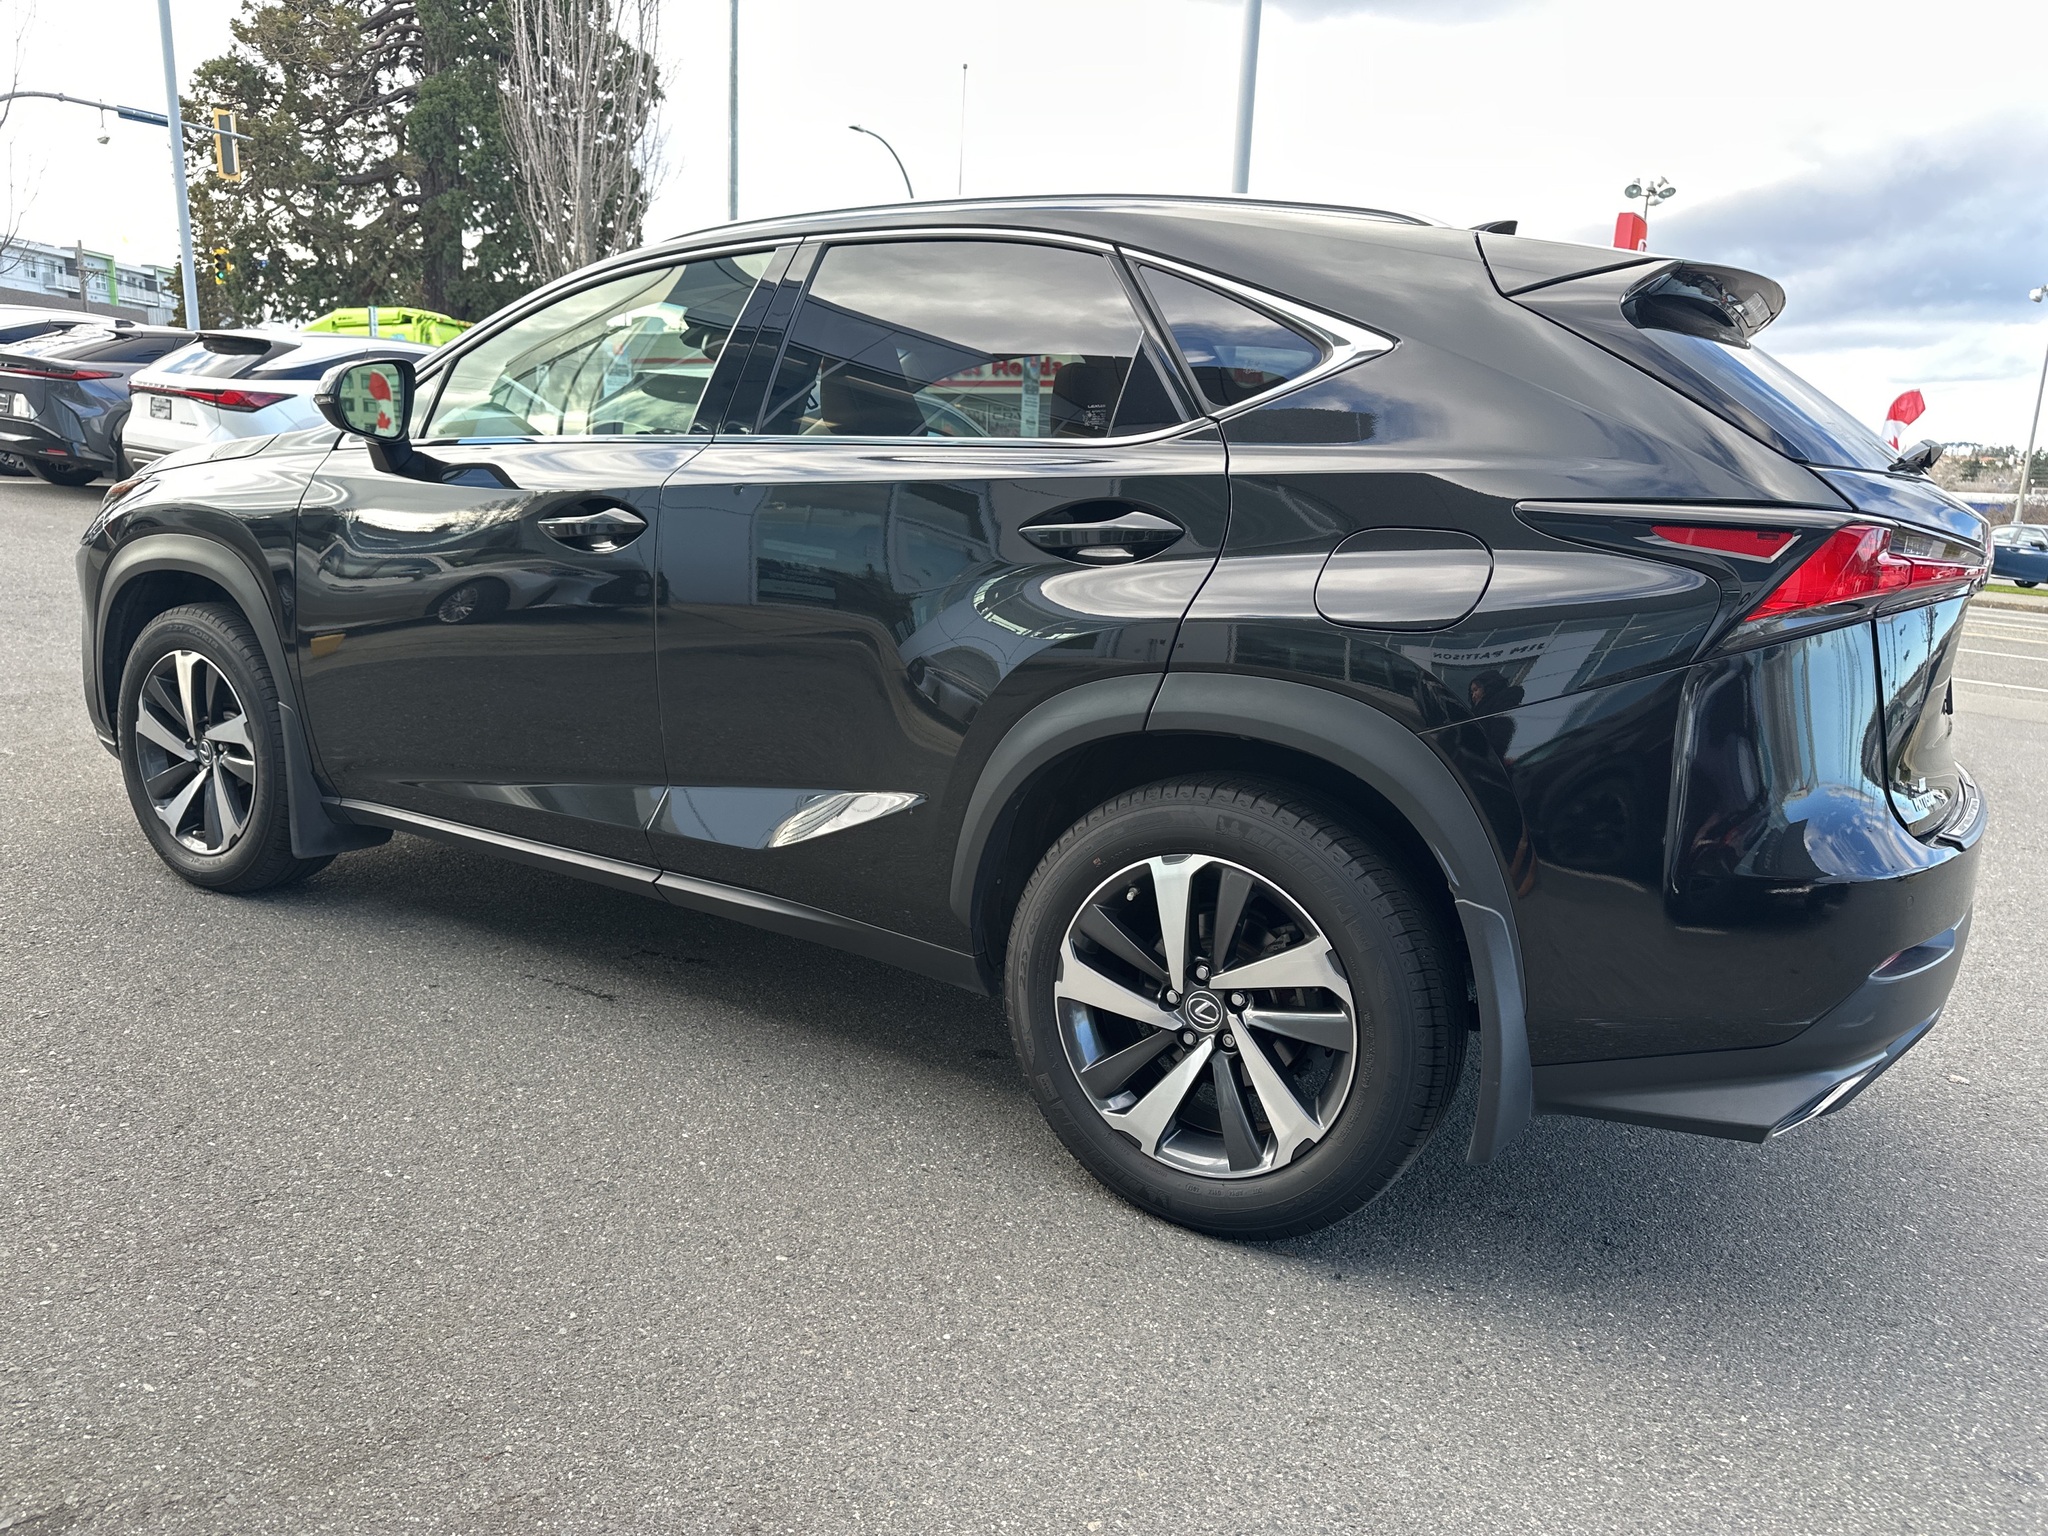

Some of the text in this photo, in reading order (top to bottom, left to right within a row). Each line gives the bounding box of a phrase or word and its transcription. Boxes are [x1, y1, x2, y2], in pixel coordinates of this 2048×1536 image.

[992, 356, 1063, 376] Hoda
[1245, 827, 1357, 919] MICHELIN
[1051, 1103, 1144, 1194] MICHELIN
